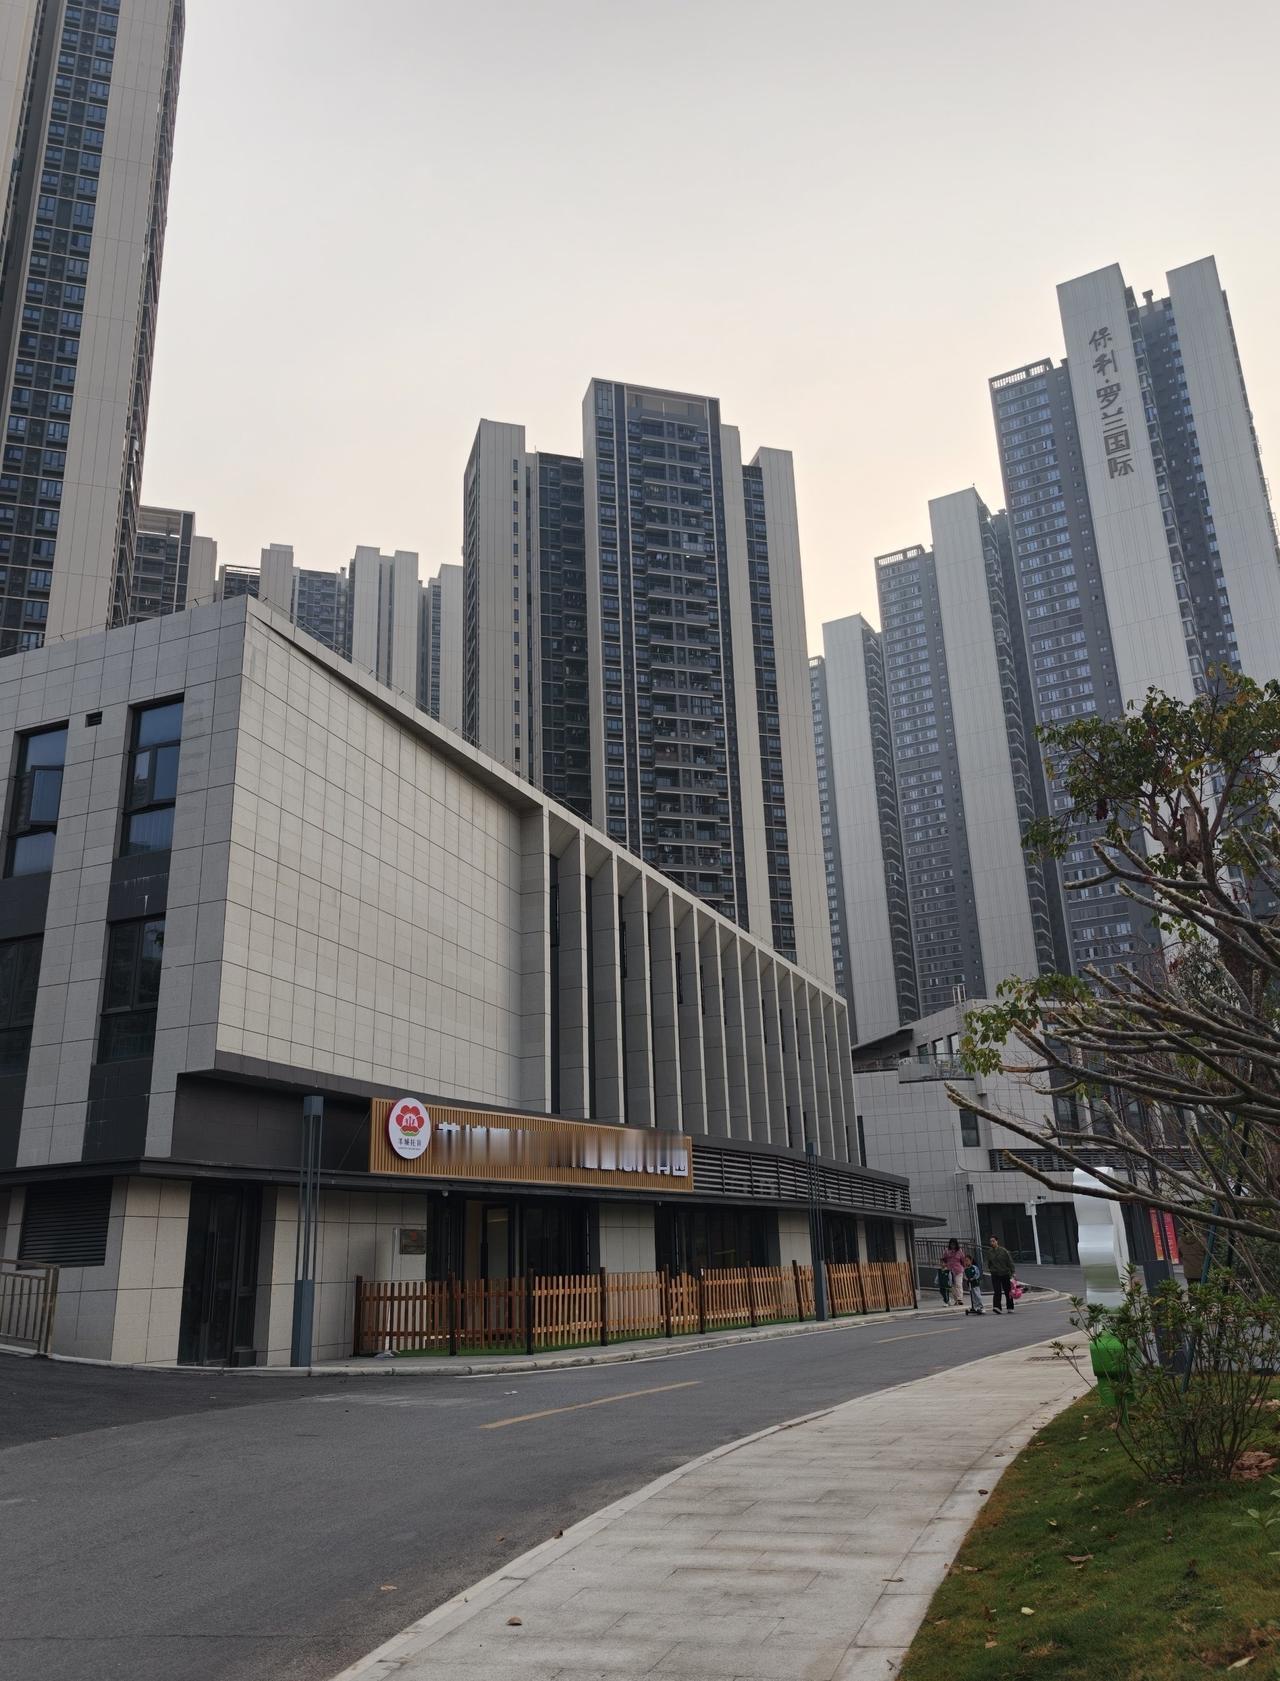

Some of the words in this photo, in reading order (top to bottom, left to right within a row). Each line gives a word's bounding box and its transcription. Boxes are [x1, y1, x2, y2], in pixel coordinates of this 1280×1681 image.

[1088, 326, 1134, 479] 保利·罗兰国际
